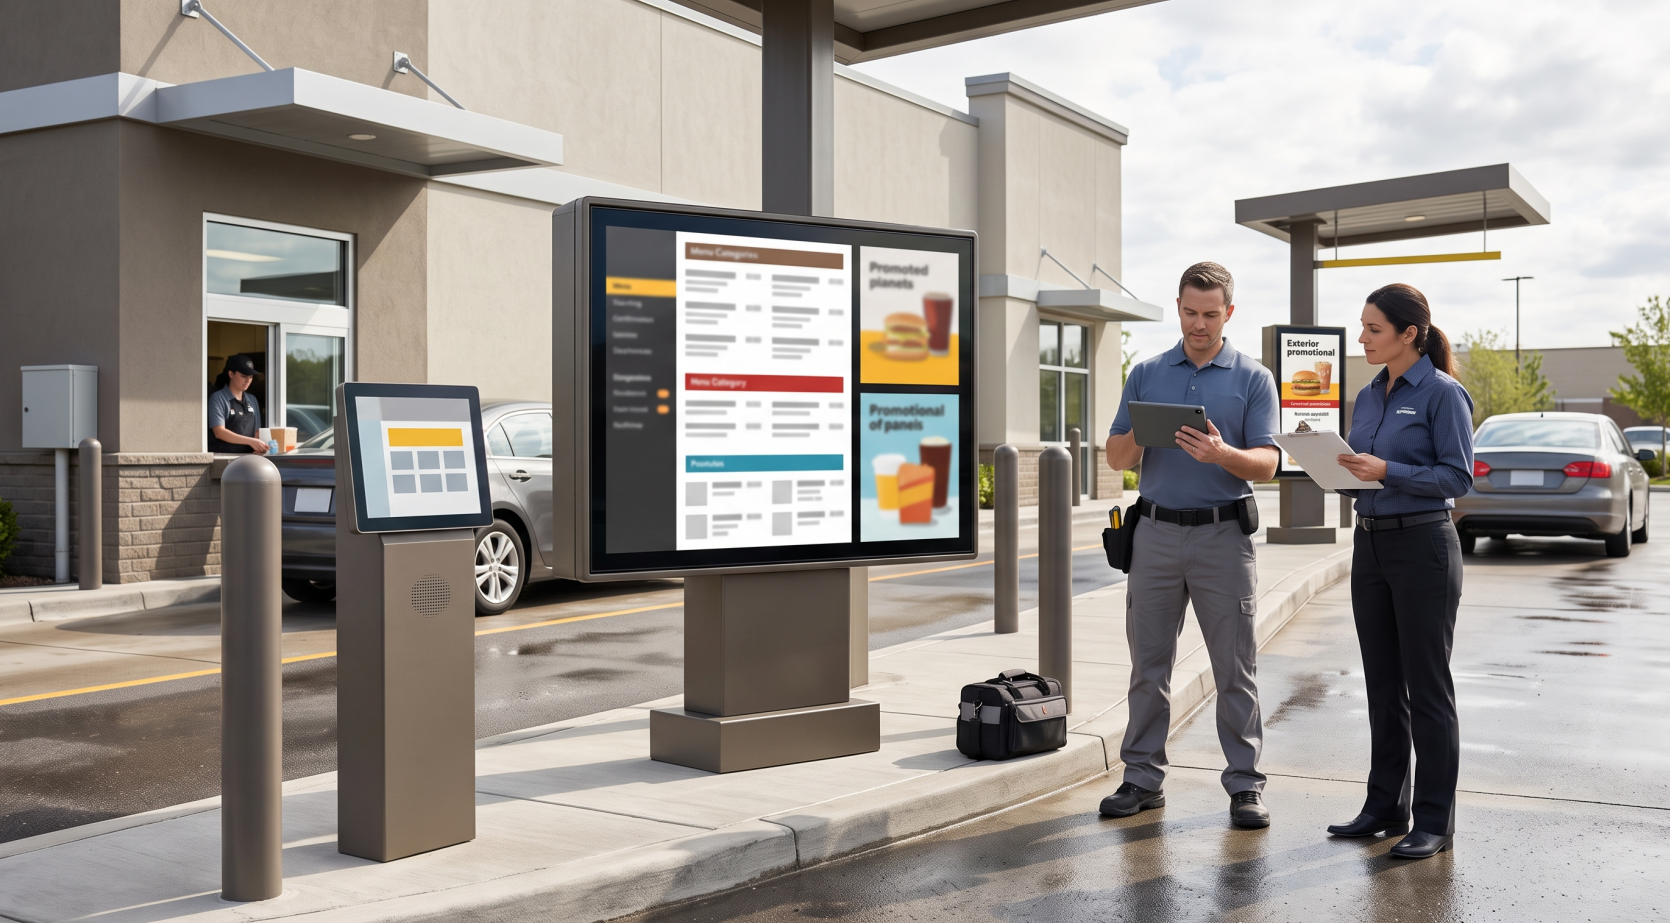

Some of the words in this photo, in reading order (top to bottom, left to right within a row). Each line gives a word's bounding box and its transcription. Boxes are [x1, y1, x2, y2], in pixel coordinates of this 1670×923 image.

[690, 246, 714, 257] Menu
[715, 247, 759, 260] Categories
[869, 261, 929, 276] Promoted
[1287, 339, 1320, 348] Exterior
[1287, 348, 1335, 358] promotional
[711, 376, 747, 389] Category
[869, 403, 945, 417] Promotional
[869, 418, 883, 431] of
